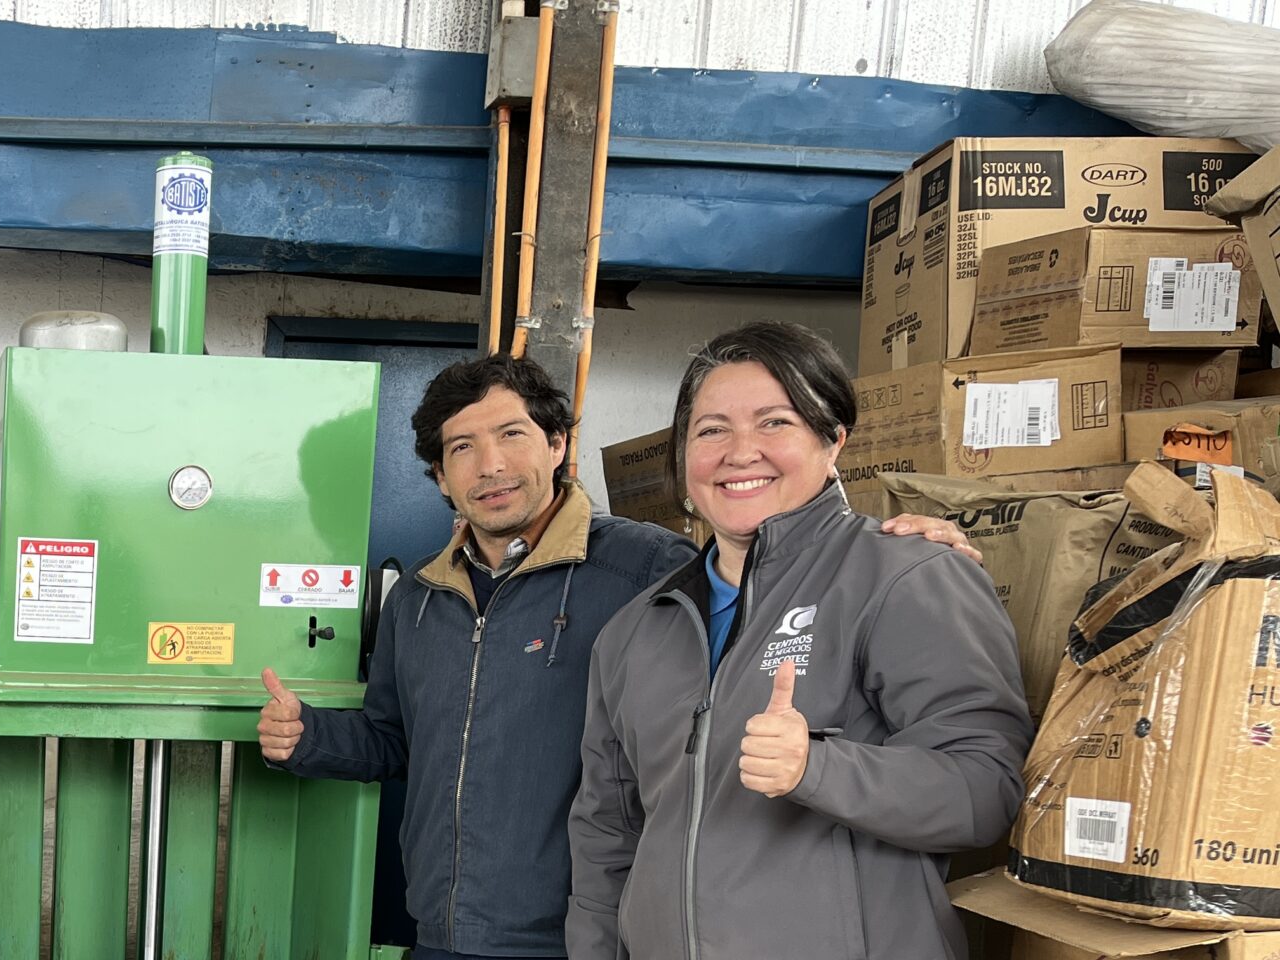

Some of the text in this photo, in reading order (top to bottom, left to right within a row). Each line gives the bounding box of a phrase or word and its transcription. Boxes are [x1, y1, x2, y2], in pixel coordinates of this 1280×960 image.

[982, 162, 1046, 174] STOCK NO.
[1202, 158, 1223, 171] 500
[1089, 169, 1139, 181] DART
[972, 176, 1052, 197] 16MJ32
[1186, 172, 1209, 193] 16
[167, 181, 205, 207] BATISTE
[957, 213, 975, 223] USE
[957, 223, 977, 233] 32JL
[956, 233, 978, 242] 32SL
[956, 242, 978, 251] 32CL
[956, 251, 978, 261] 32PL
[956, 260, 978, 270] 32RL
[956, 269, 979, 280] 32HD
[840, 464, 879, 482] CUIDADO
[1128, 520, 1174, 537] PRODUCTO
[38, 544, 89, 553] PELIGRO
[768, 634, 814, 651] CENTROS
[763, 644, 812, 658] DE NEGOCIOS
[760, 654, 810, 668] SERCOTEC
[1193, 837, 1237, 863] 180
